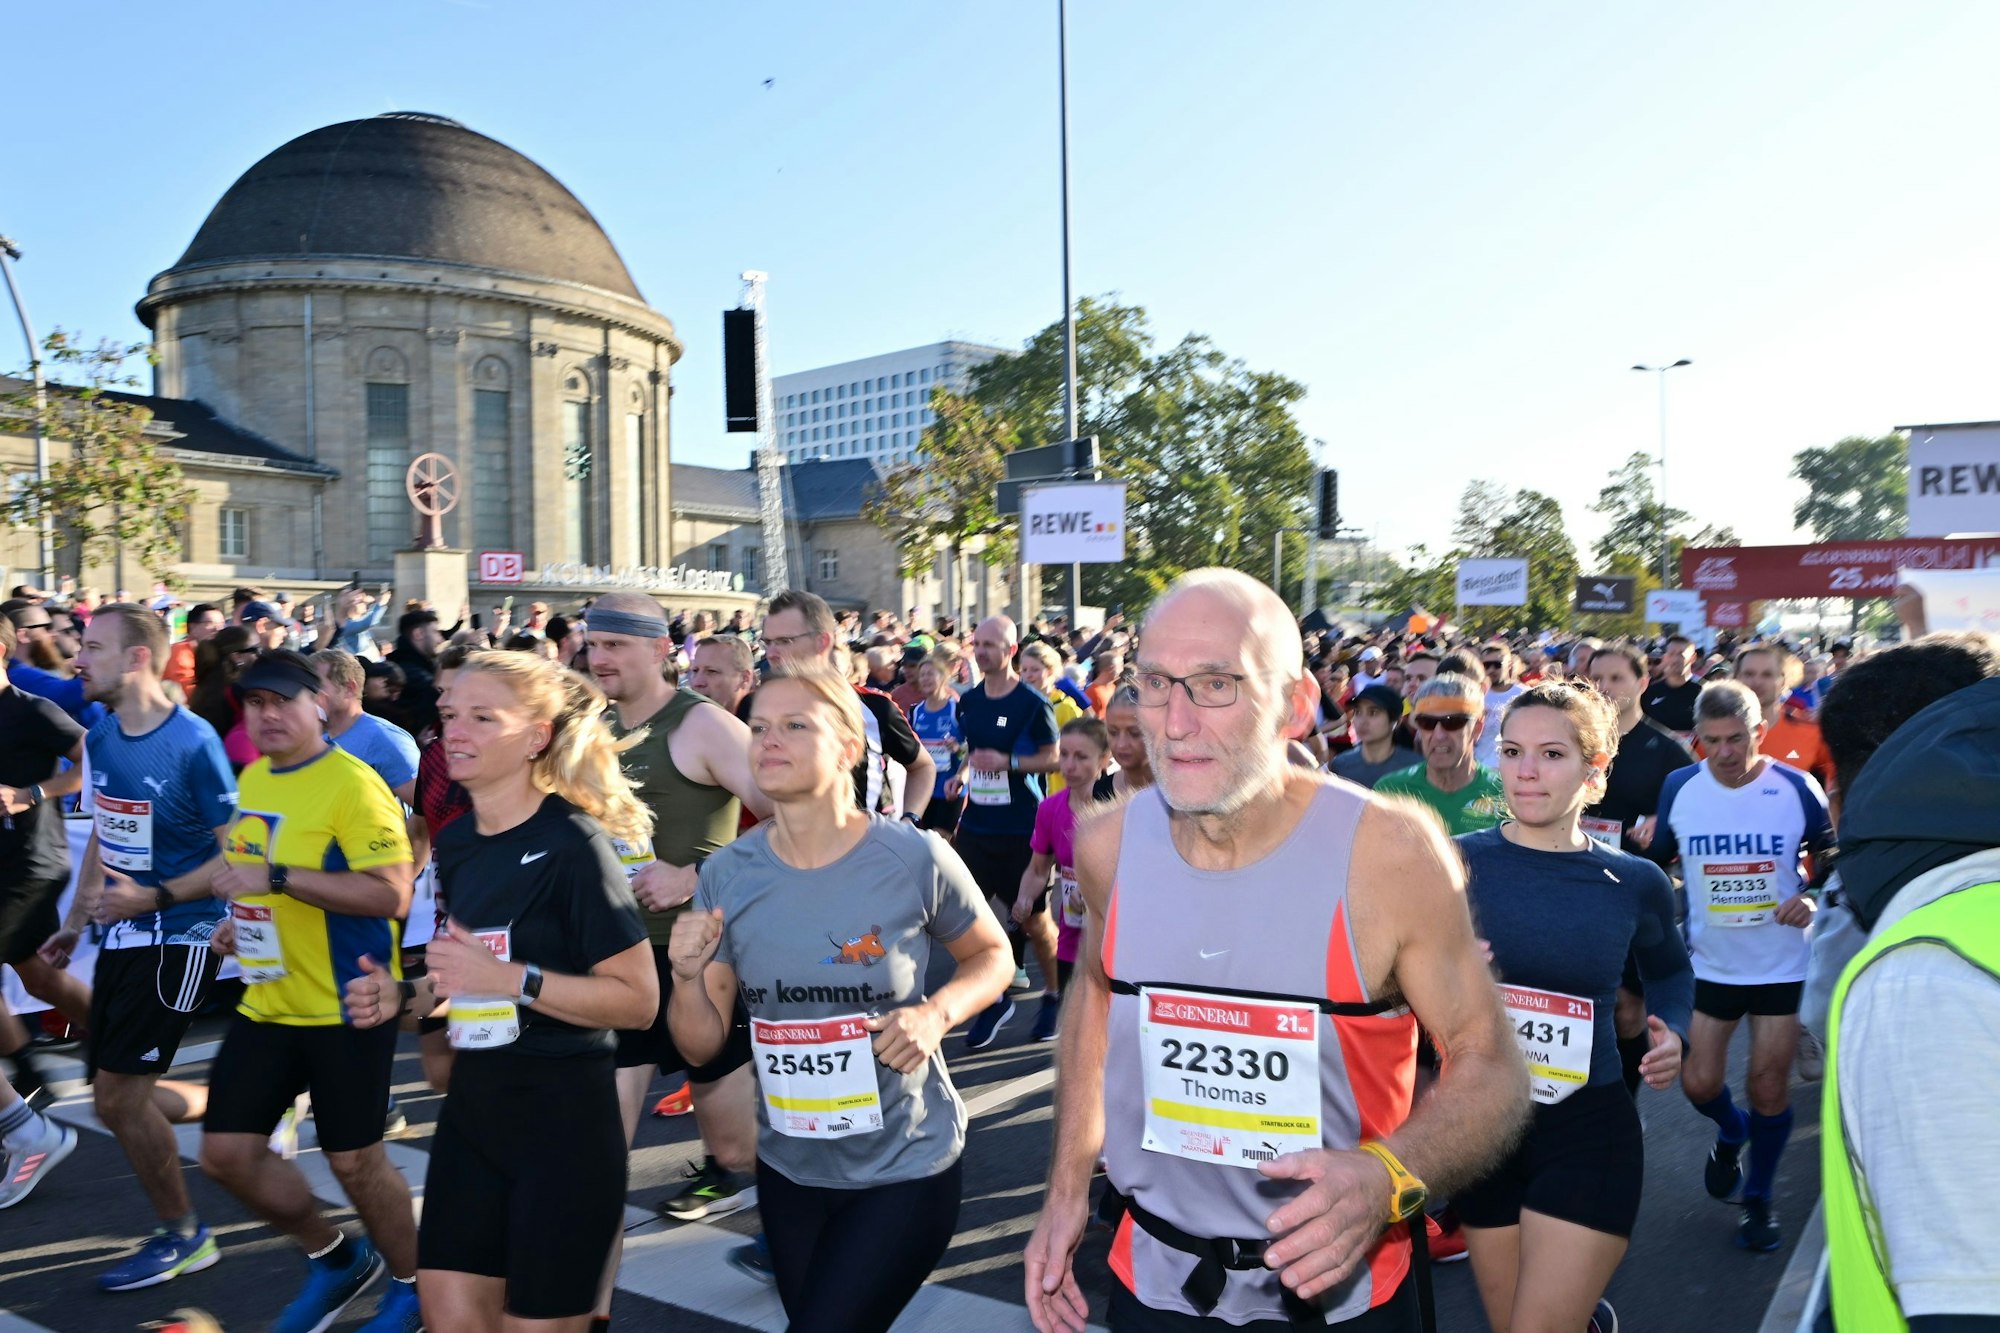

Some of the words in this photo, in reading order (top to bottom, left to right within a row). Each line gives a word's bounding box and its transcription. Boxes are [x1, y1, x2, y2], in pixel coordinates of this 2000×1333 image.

[1031, 511, 1093, 535] REWE
[487, 556, 516, 577] DB
[1689, 834, 1784, 855] MAHLE
[1711, 879, 1767, 892] 25333
[1711, 893, 1771, 904] Hermann
[1176, 1004, 1249, 1027] GENERALI
[770, 1028, 821, 1041] GENERALI
[1510, 1017, 1570, 1047] 431
[766, 1050, 852, 1075] 25457
[1161, 1038, 1289, 1081] 22330
[1181, 1077, 1267, 1105] Thomas
[828, 1122, 850, 1131] PUMA
[1260, 1120, 1294, 1128] STARTBLOCK
[1296, 1121, 1310, 1129] GELB
[1242, 1148, 1273, 1161] PUMA
